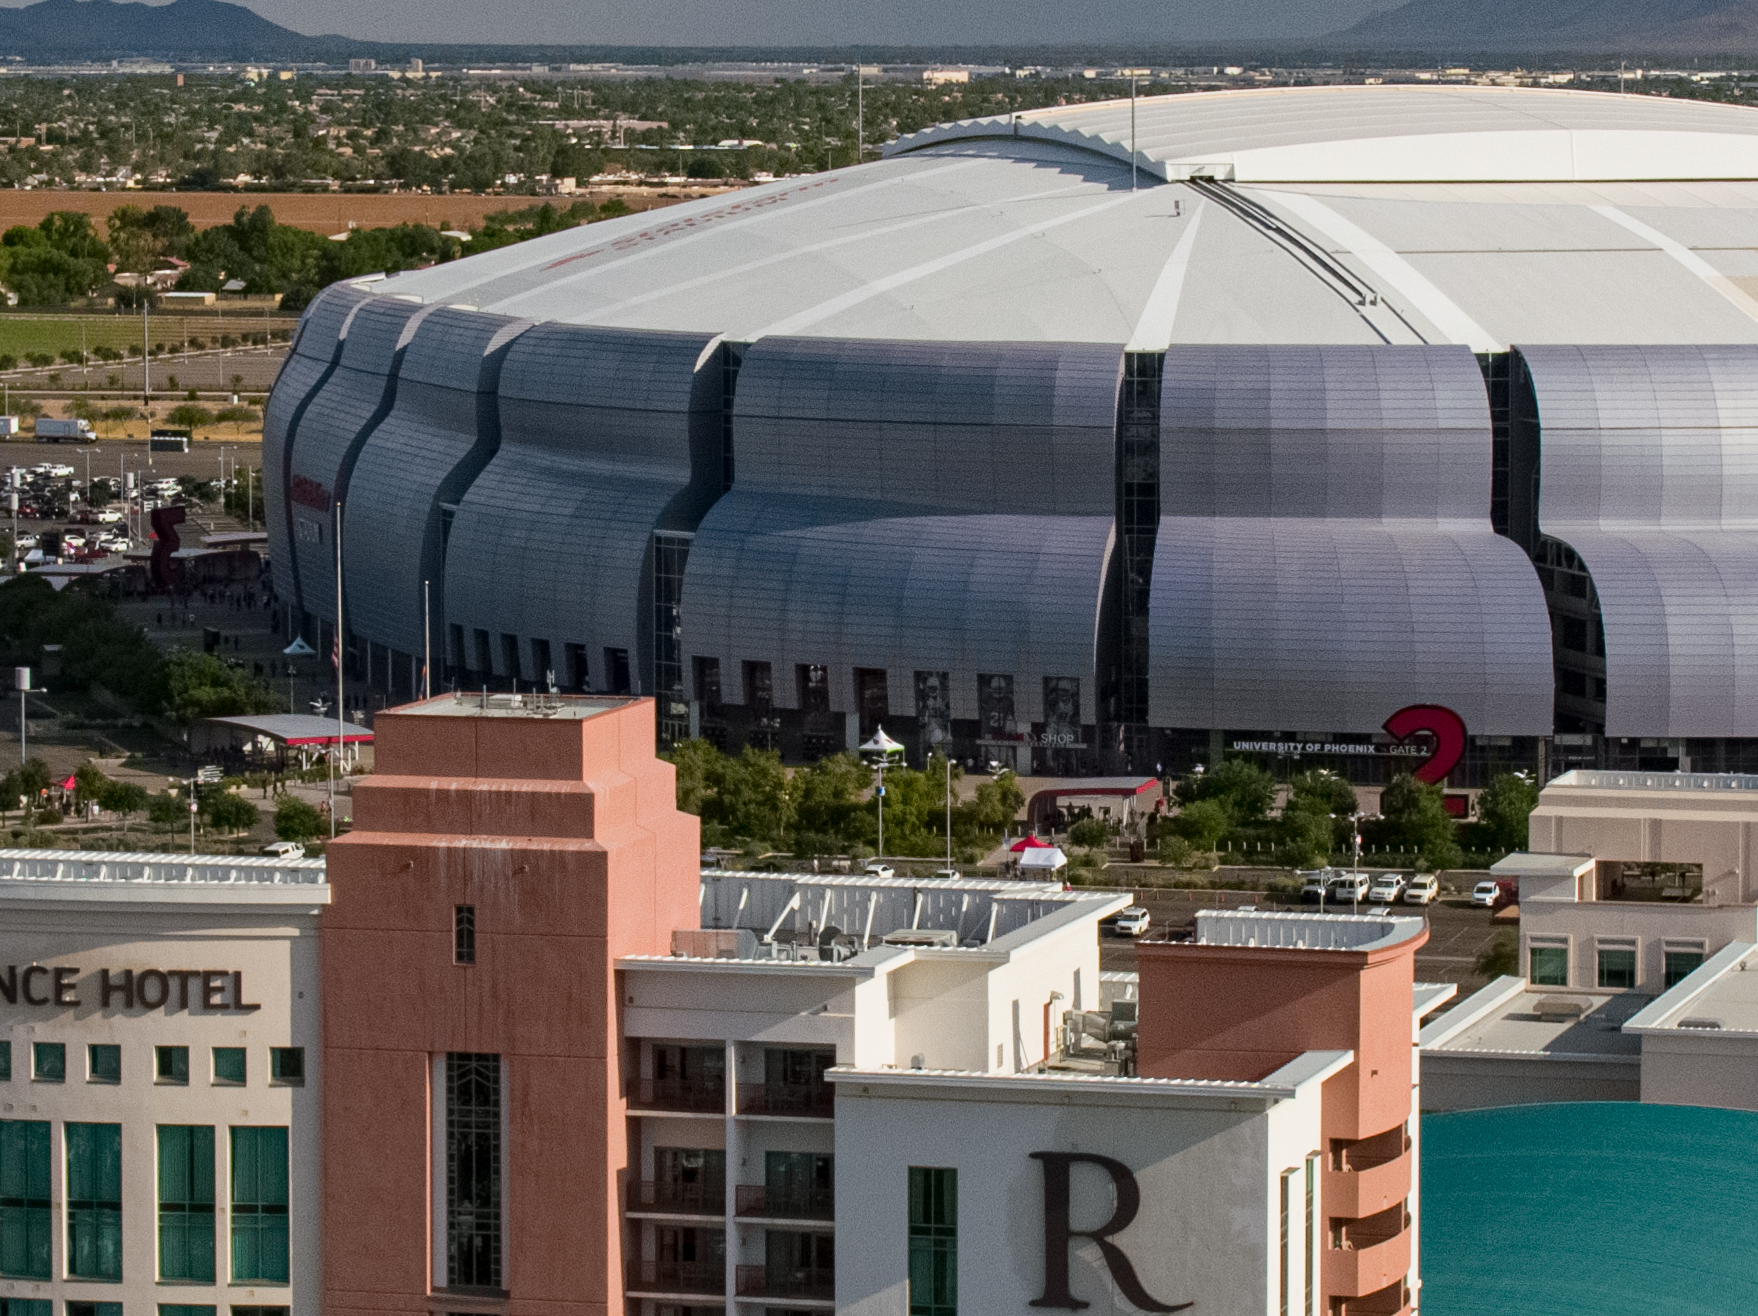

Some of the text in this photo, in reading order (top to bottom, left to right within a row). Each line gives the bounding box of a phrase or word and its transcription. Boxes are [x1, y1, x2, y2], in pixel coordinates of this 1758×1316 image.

[1041, 733, 1075, 744] SHOP
[1233, 740, 1376, 754] UNIVERSITY OF PHOENIX
[1389, 745, 1417, 755] GATE
[101, 968, 261, 1012] HOTEL
[1029, 1151, 1195, 1315] R
